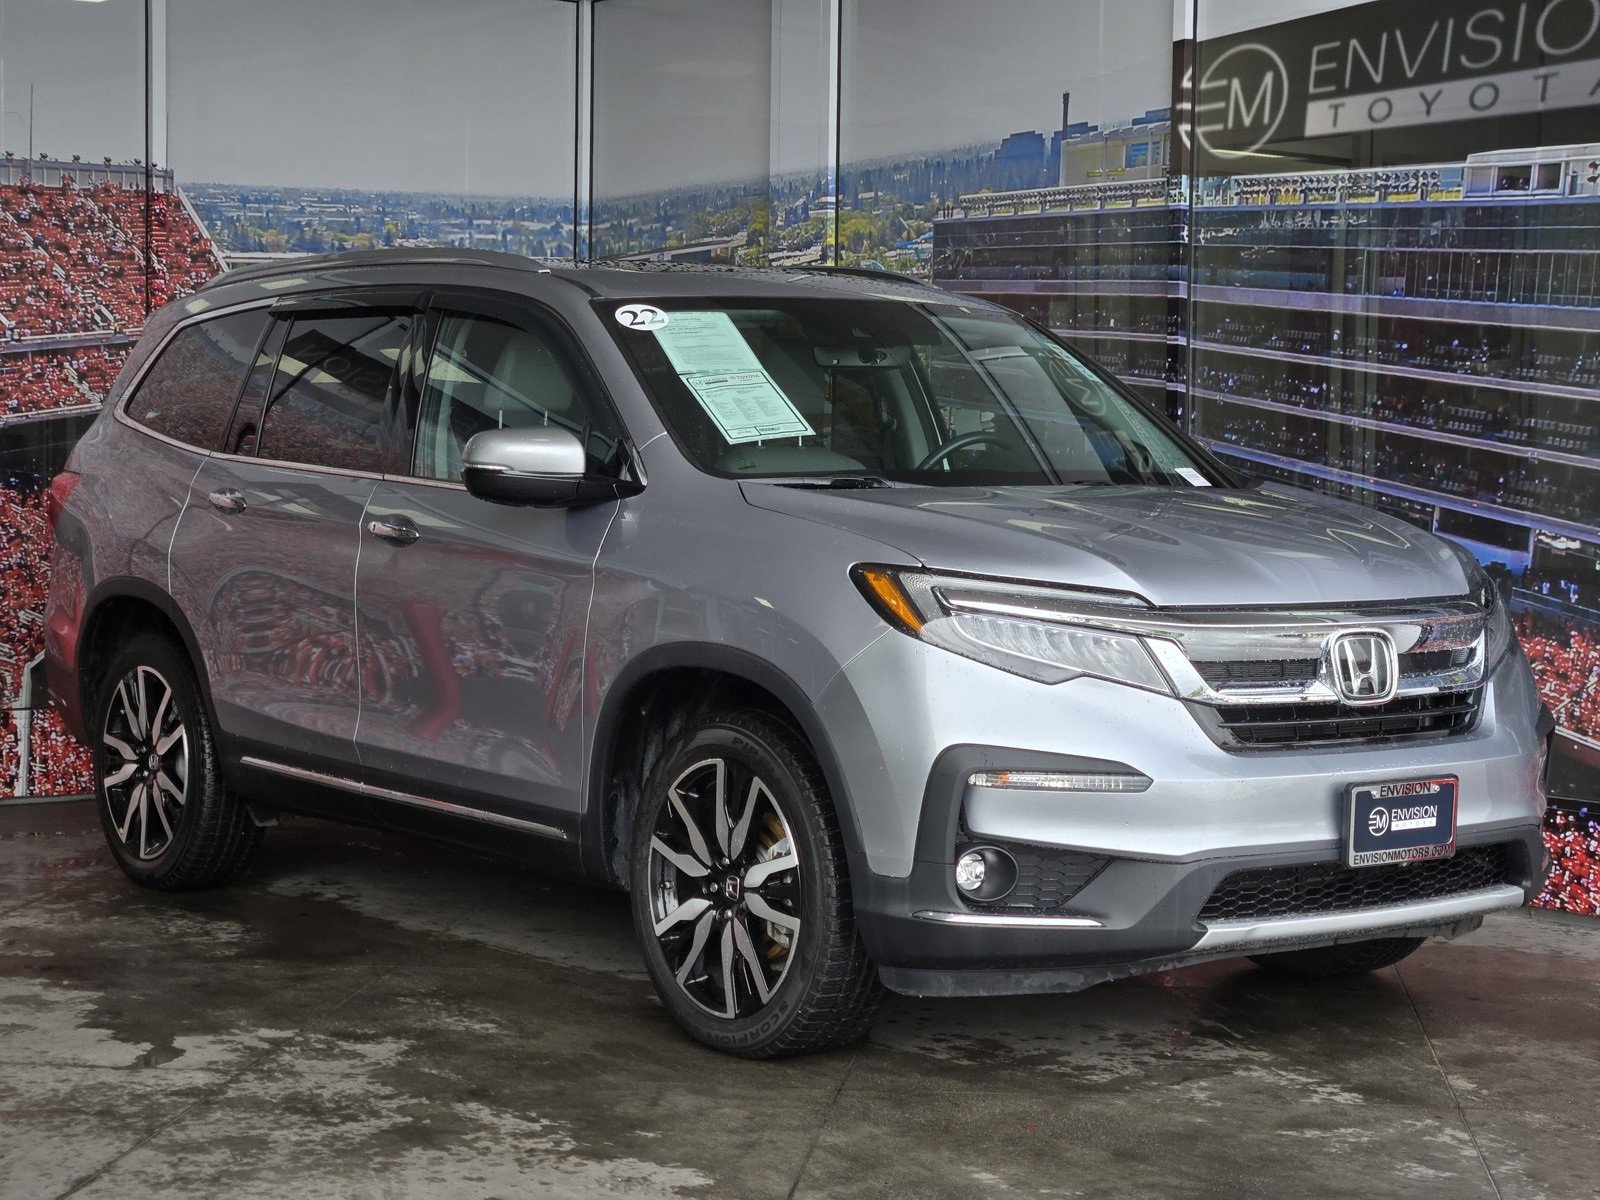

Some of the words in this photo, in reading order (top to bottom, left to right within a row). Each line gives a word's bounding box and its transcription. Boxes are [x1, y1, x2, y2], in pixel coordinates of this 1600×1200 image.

[620, 308, 665, 327] 22
[1379, 781, 1431, 798] ENVISION
[1391, 805, 1438, 821] ENVISION
[1395, 820, 1434, 829] MOTORS
